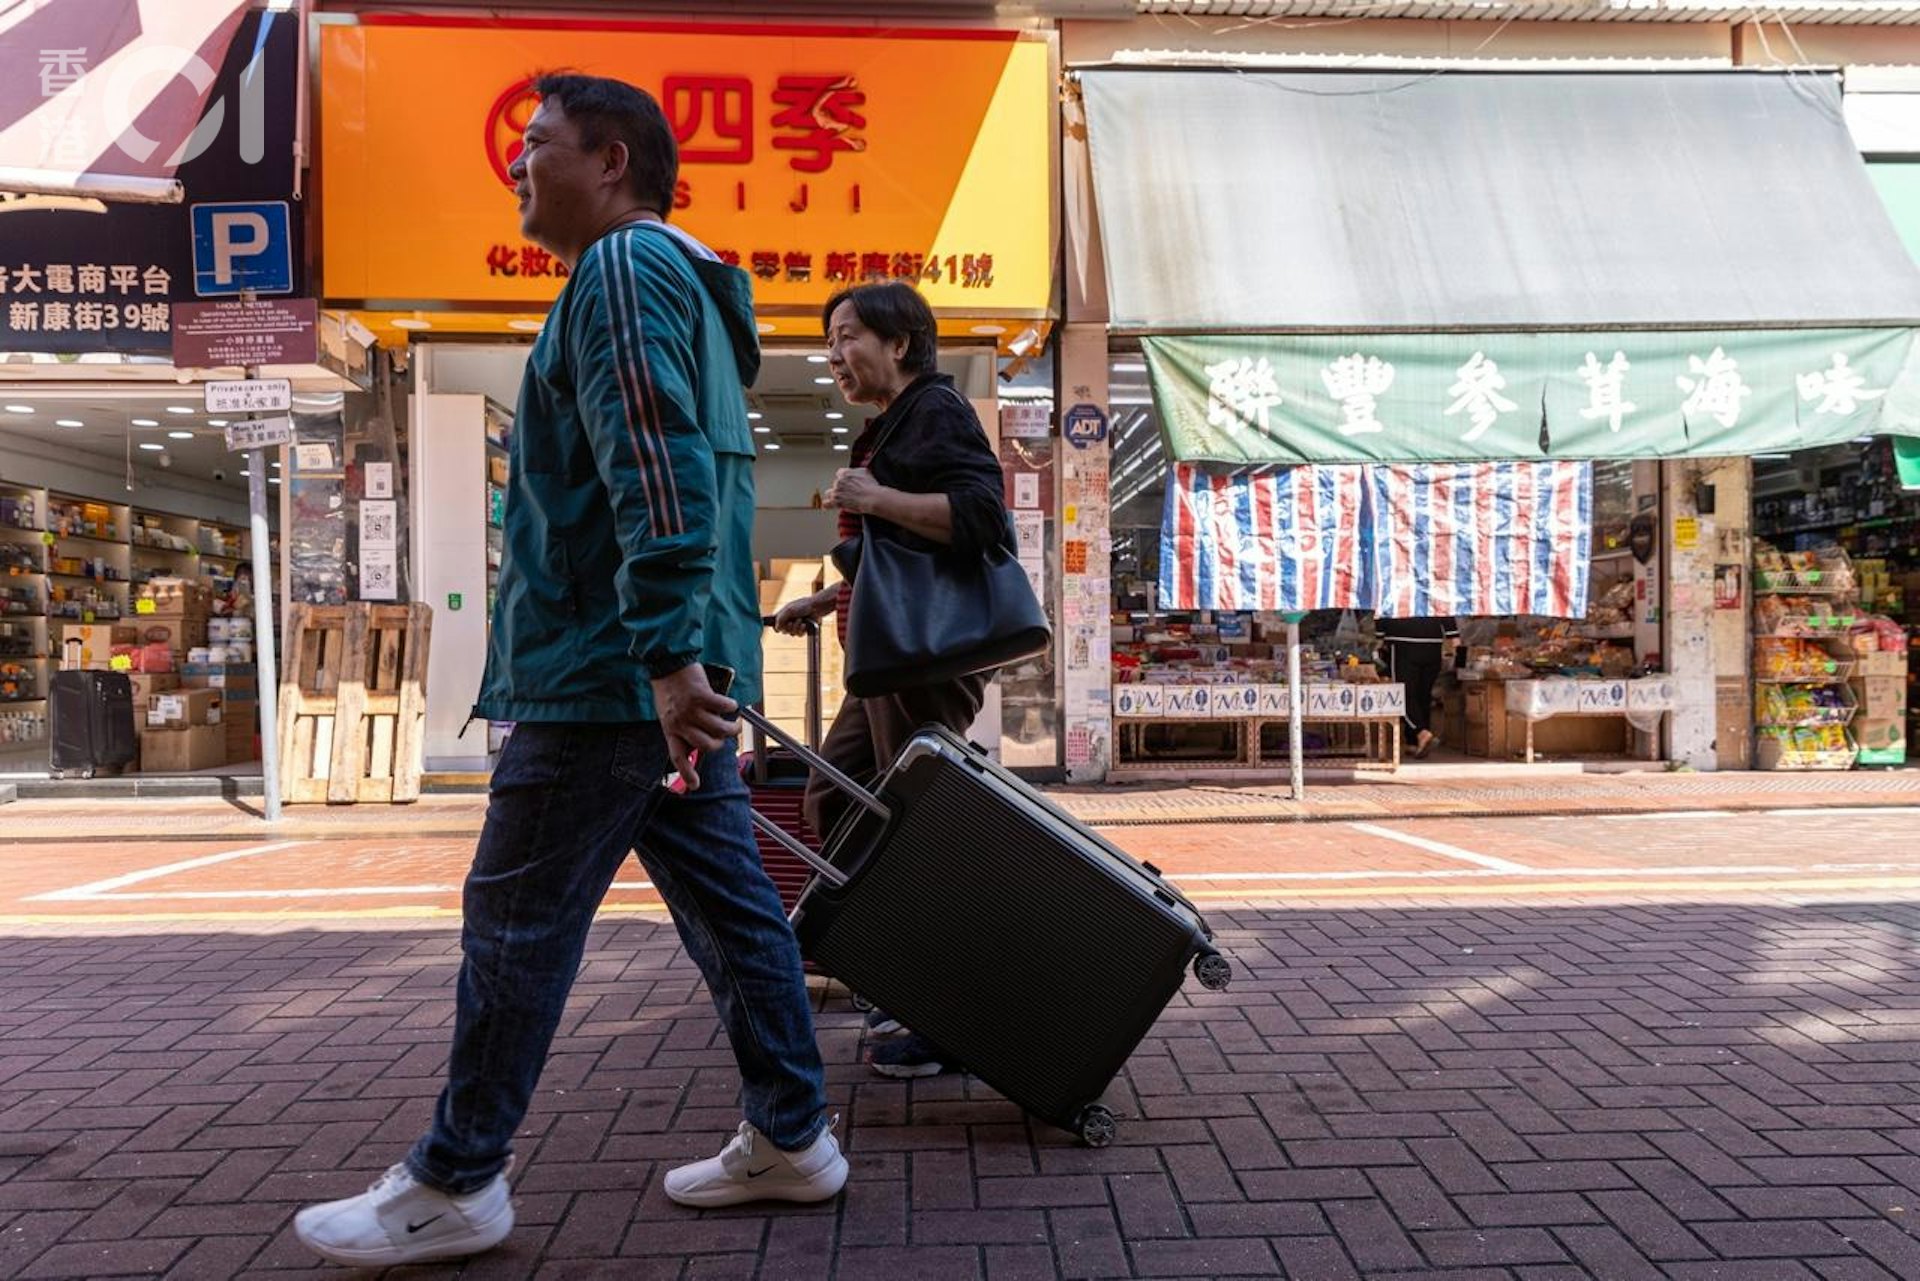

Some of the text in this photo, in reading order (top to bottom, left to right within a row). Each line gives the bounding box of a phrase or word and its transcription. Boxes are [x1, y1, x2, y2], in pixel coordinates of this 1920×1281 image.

[662, 73, 867, 173] 四季
[211, 211, 269, 285] P
[9, 301, 170, 333] 新康街39號
[1069, 418, 1101, 436] ADT
